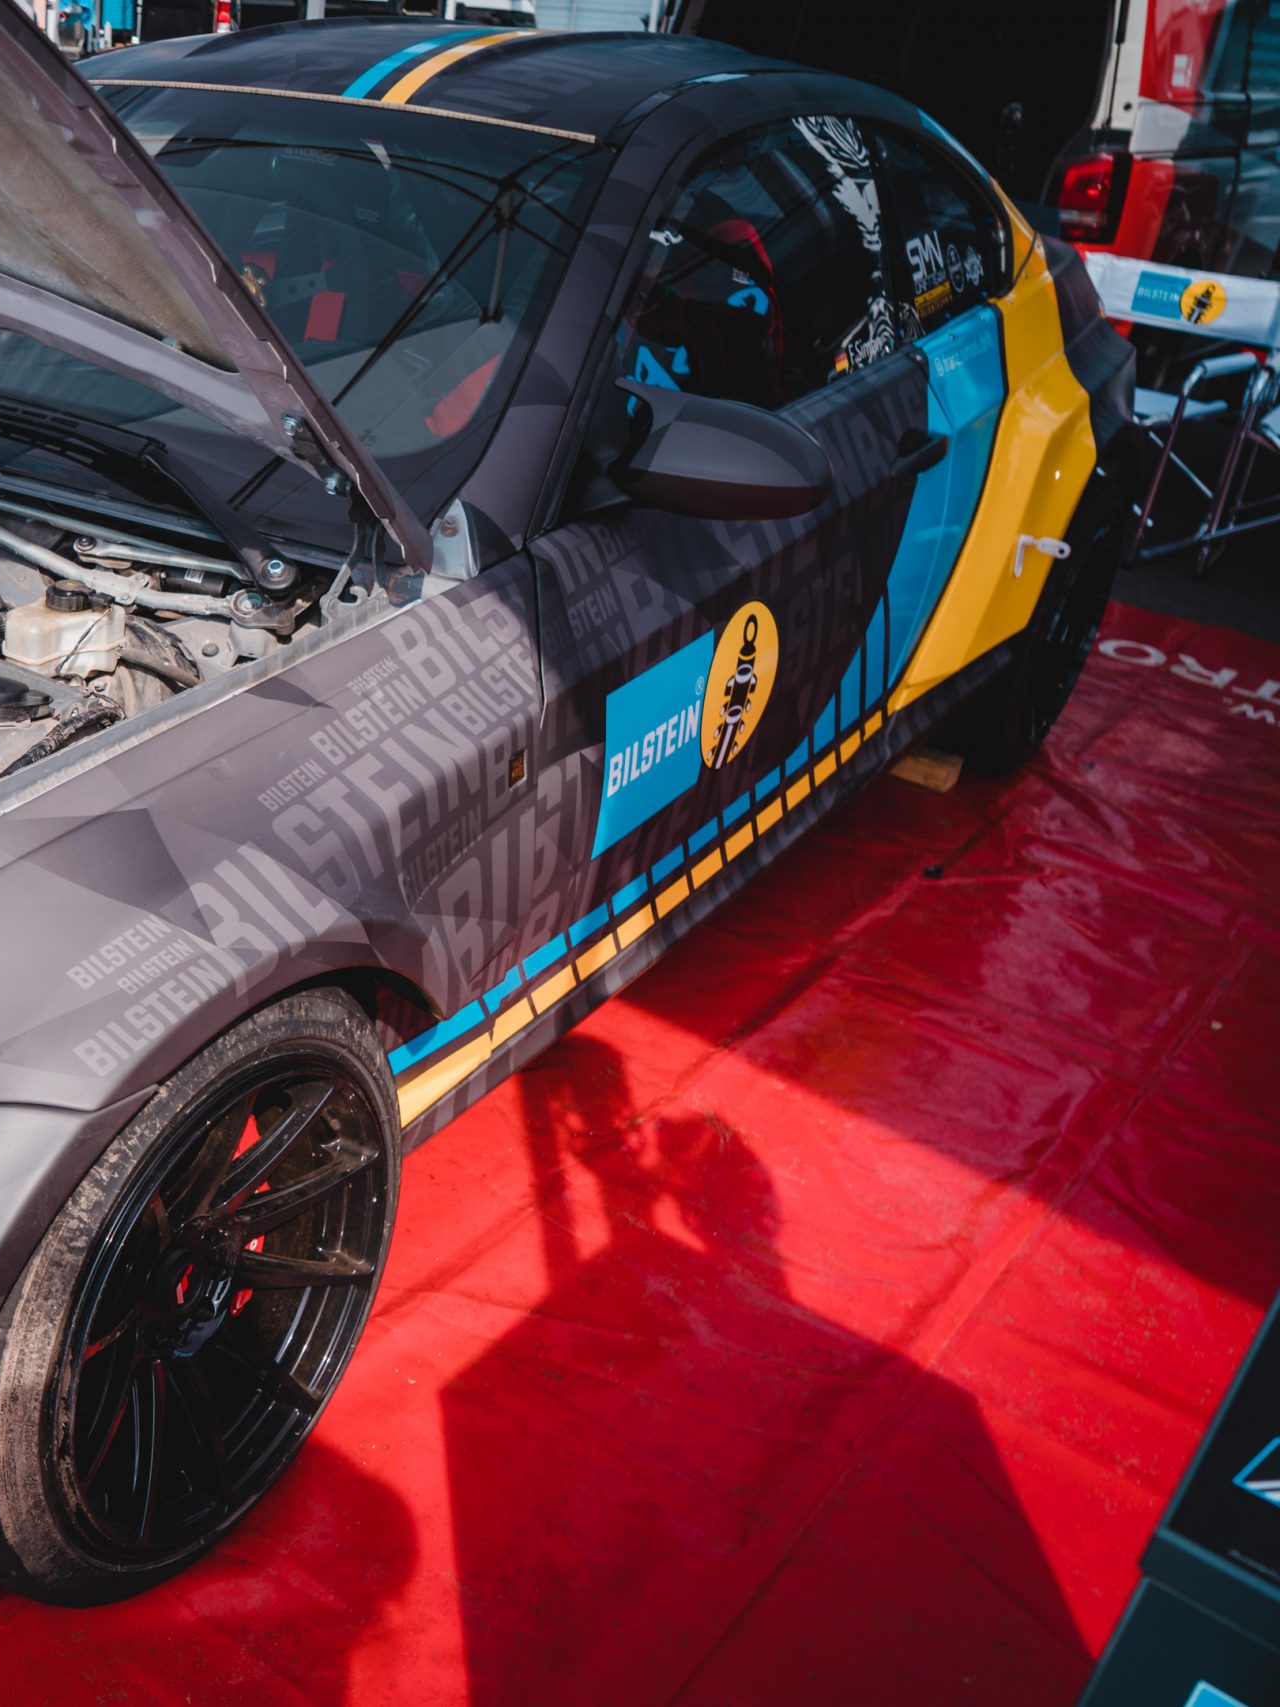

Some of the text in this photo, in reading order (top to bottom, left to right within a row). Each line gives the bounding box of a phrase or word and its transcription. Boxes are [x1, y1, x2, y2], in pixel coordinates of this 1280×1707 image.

[1137, 286, 1180, 304] BILSTEIN
[347, 654, 400, 696] BILSTEIN
[308, 673, 429, 767] BILSTEIN
[606, 701, 701, 798] BILSTEIN
[257, 758, 328, 813] BILSTEIN
[159, 706, 483, 998] BILSTEIN
[65, 914, 172, 991] BILSTEIN
[116, 938, 195, 996] BILSTEIN
[72, 957, 230, 1077] BILSTEIN
